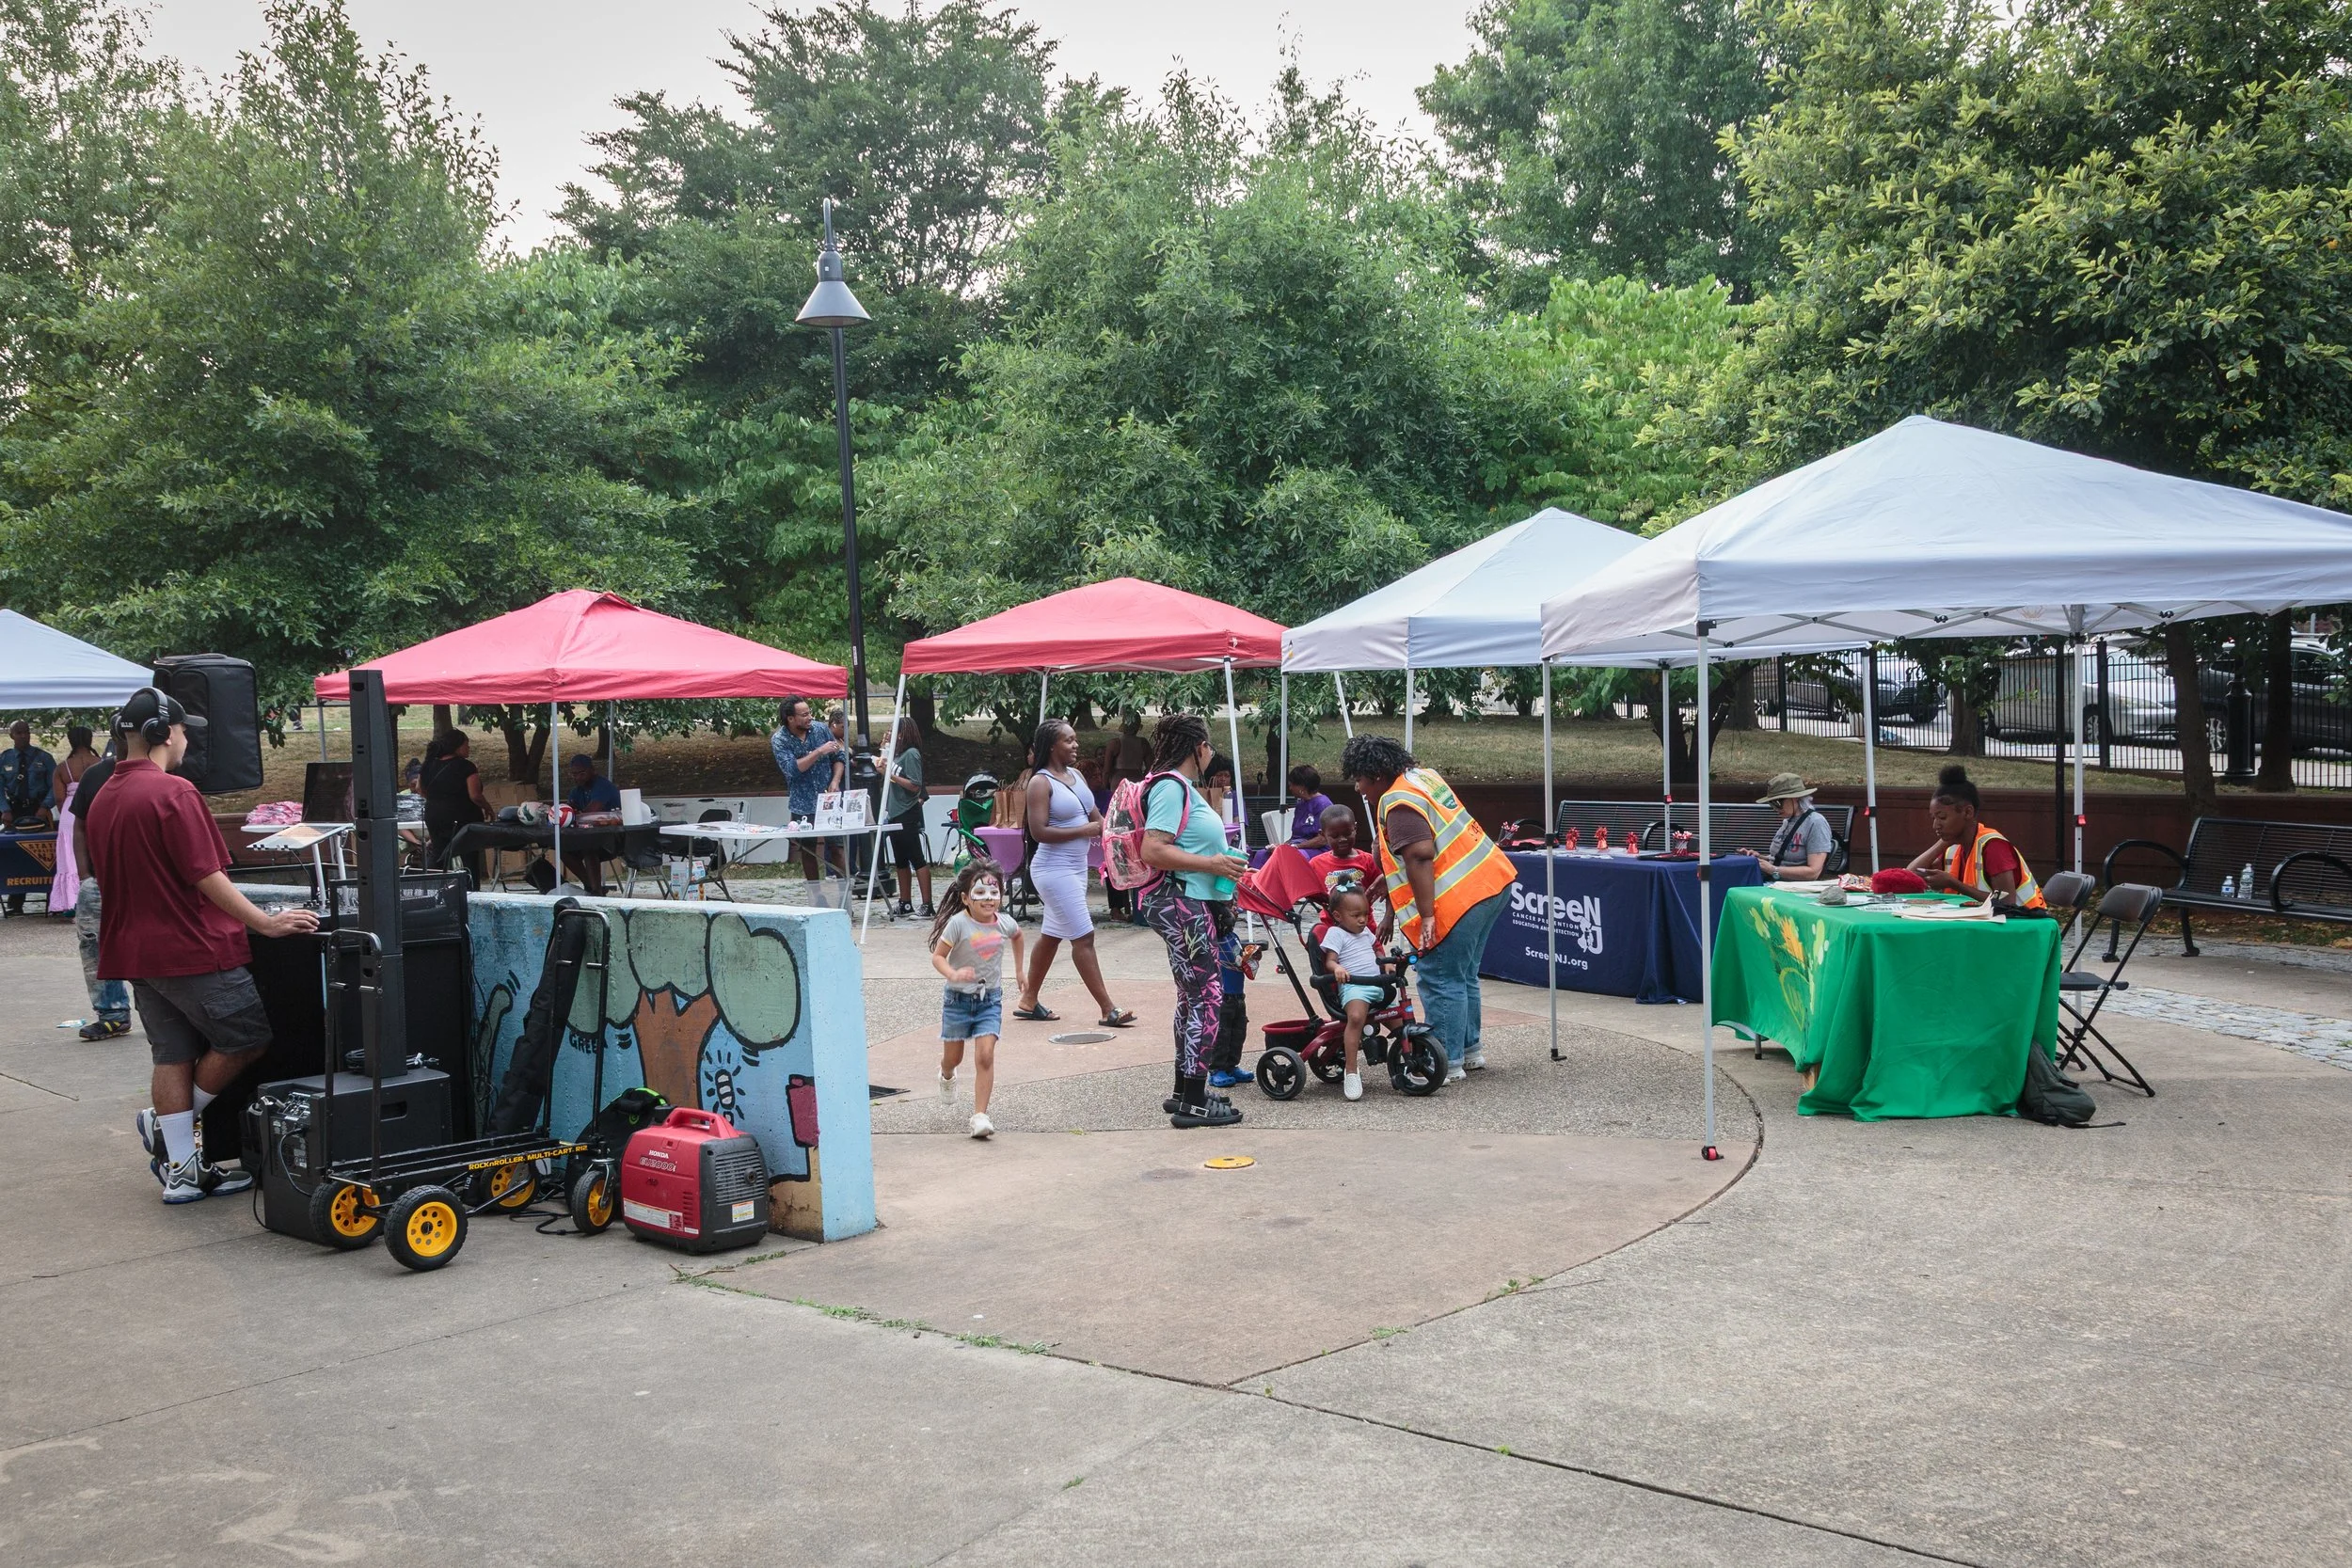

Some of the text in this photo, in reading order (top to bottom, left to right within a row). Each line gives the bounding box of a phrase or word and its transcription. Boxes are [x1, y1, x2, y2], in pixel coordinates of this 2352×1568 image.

[7, 877, 53, 886] RECRUITI
[1512, 911, 1580, 930] CANCER PREENTION
[1512, 919, 1539, 929] EDUCATION
[1525, 946, 1588, 970] ScreeNJ.org
[569, 1033, 608, 1054] GREE
[649, 1149, 669, 1159] HONDA
